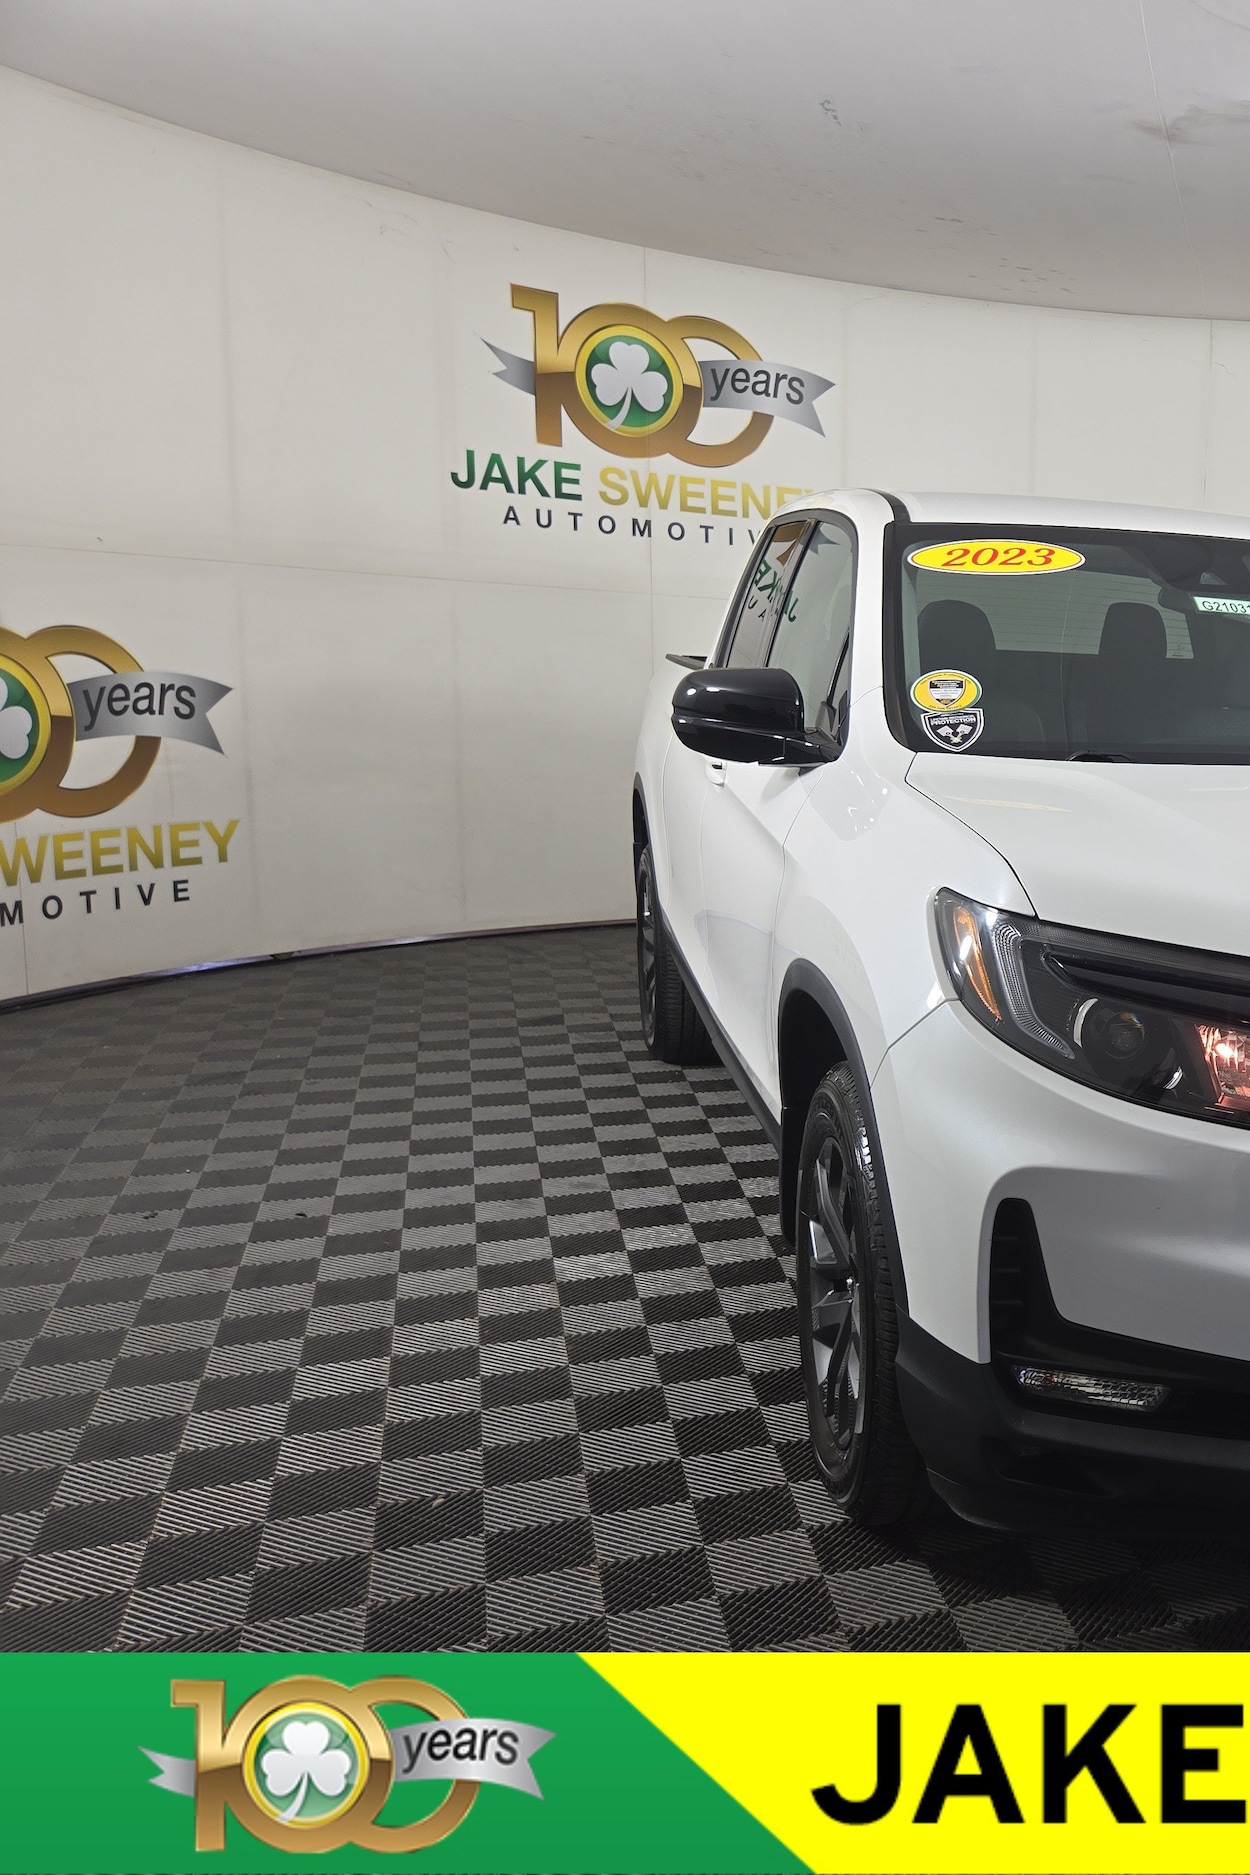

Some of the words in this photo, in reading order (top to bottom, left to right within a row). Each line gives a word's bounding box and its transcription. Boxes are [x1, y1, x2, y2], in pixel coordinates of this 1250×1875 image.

[511, 283, 774, 467] 100
[710, 368, 805, 404] years
[451, 449, 583, 501] JAKE
[599, 467, 812, 520] SWEENE
[941, 547, 1056, 566] 2023
[83, 681, 197, 732] years
[0, 819, 240, 887] WEENEY
